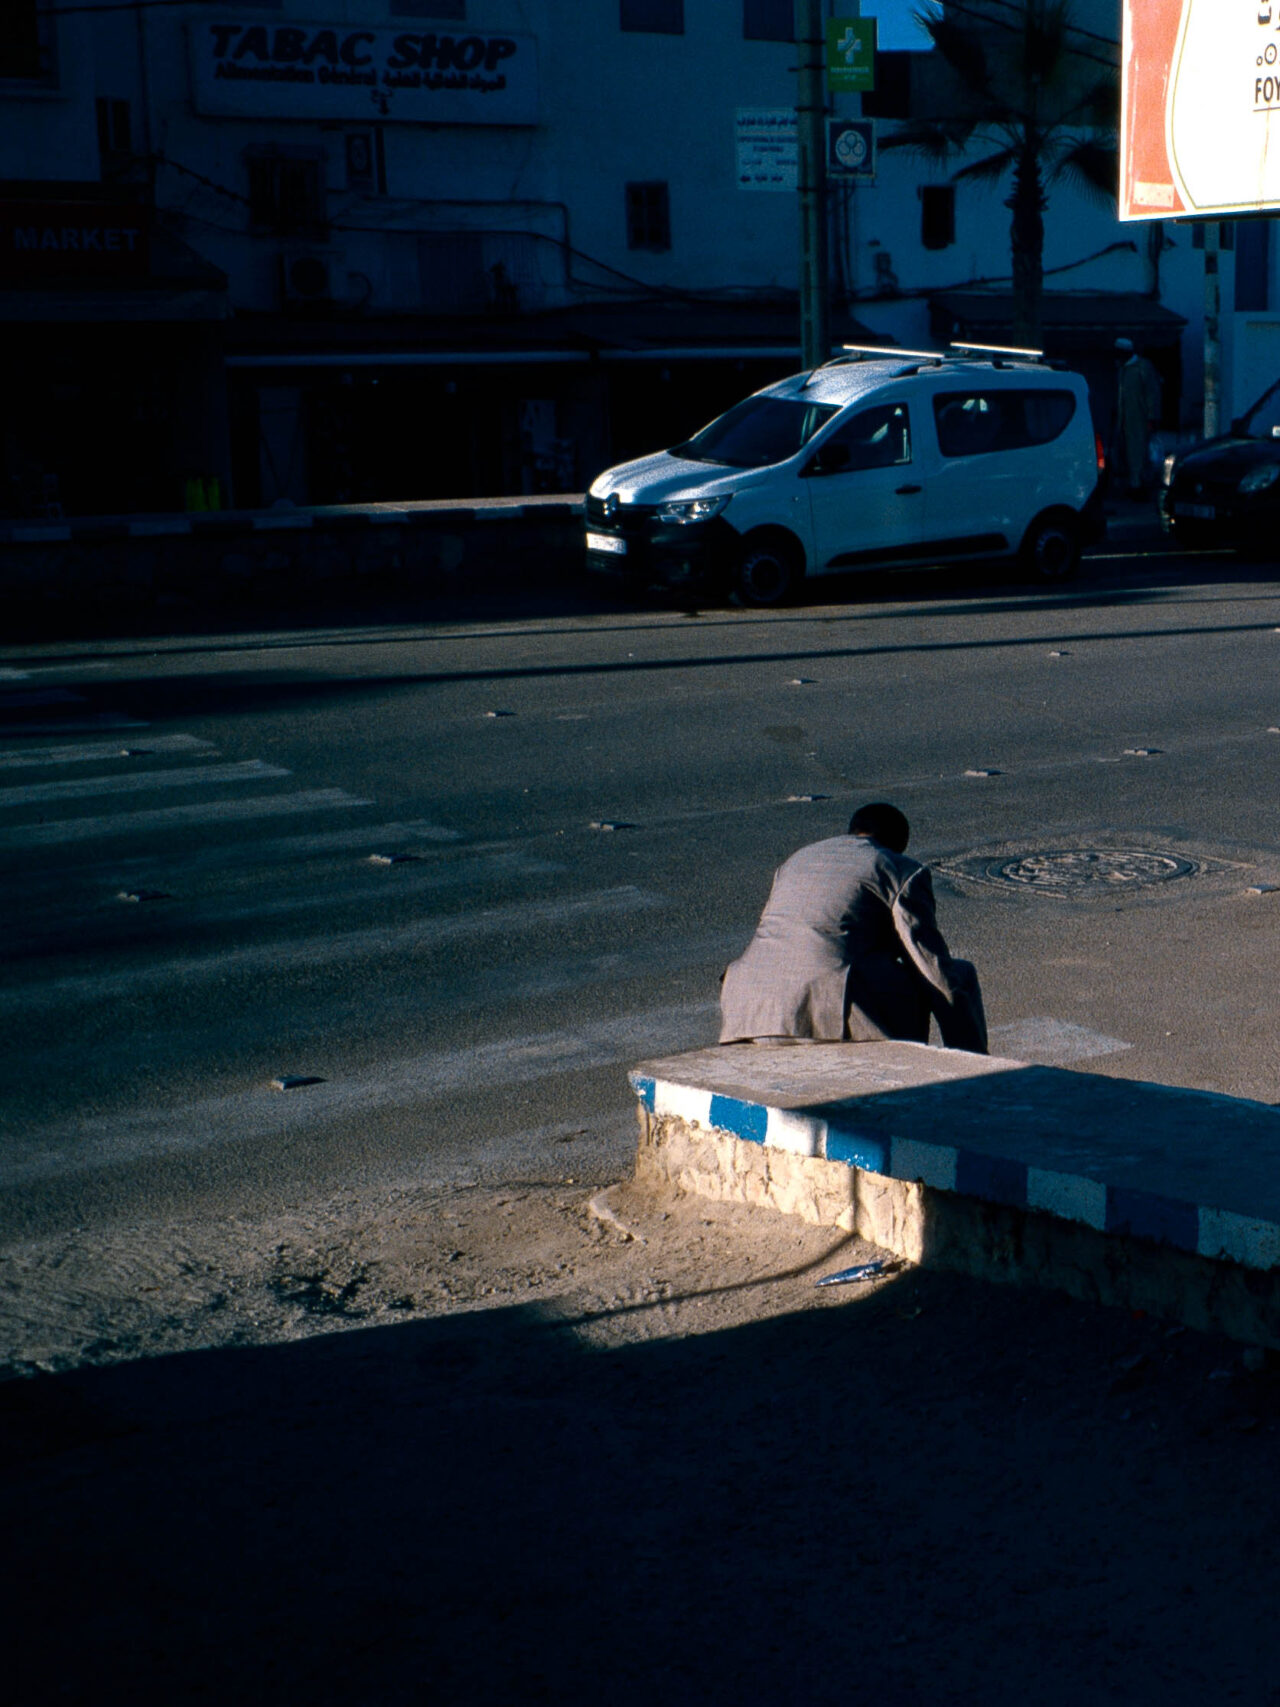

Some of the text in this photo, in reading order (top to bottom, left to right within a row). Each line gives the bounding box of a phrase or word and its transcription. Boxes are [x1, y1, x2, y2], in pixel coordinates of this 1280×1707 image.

[209, 25, 517, 71] TABAC SHOP
[12, 224, 142, 253] MARKET
